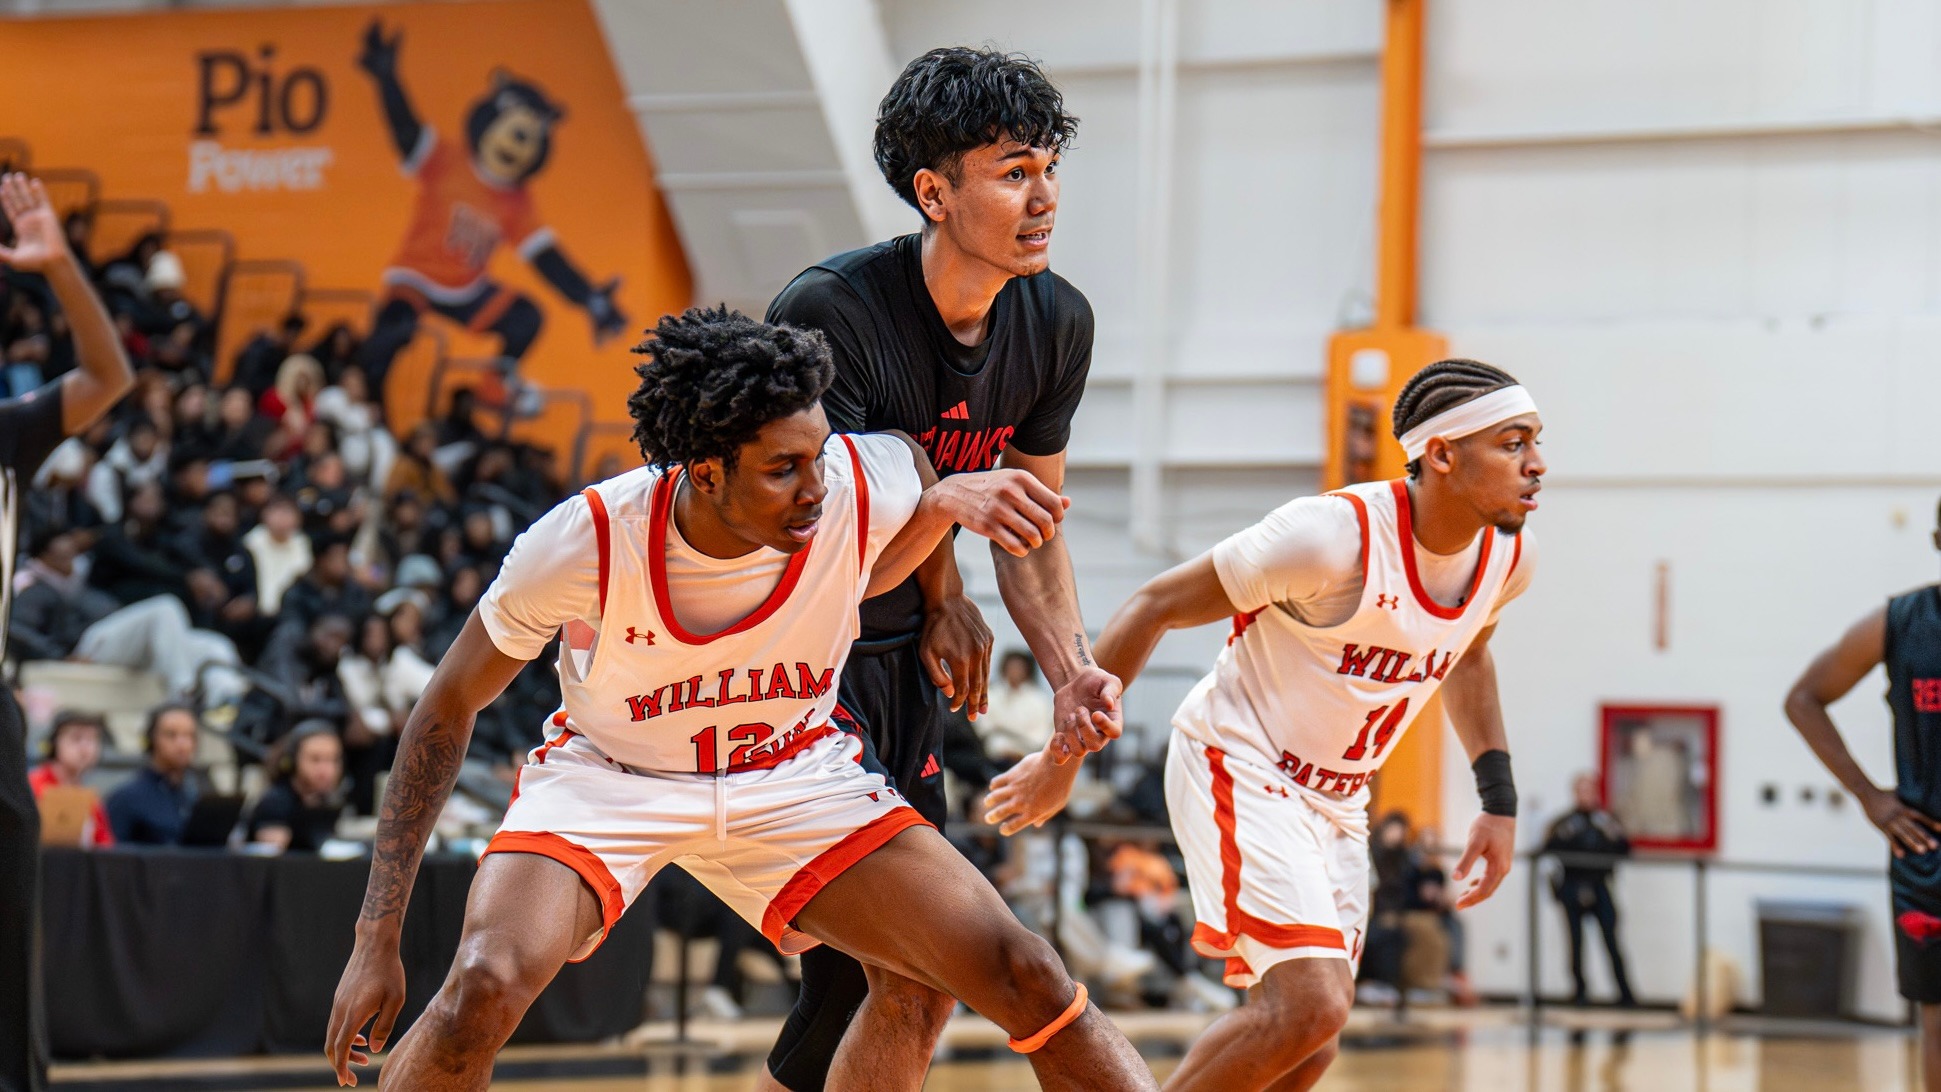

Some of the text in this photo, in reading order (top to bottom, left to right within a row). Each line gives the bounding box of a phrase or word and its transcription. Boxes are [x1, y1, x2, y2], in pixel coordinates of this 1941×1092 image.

[195, 44, 329, 135] Pio
[188, 140, 333, 193] Power
[625, 662, 835, 722] WILLIAM
[690, 722, 775, 773] 12
